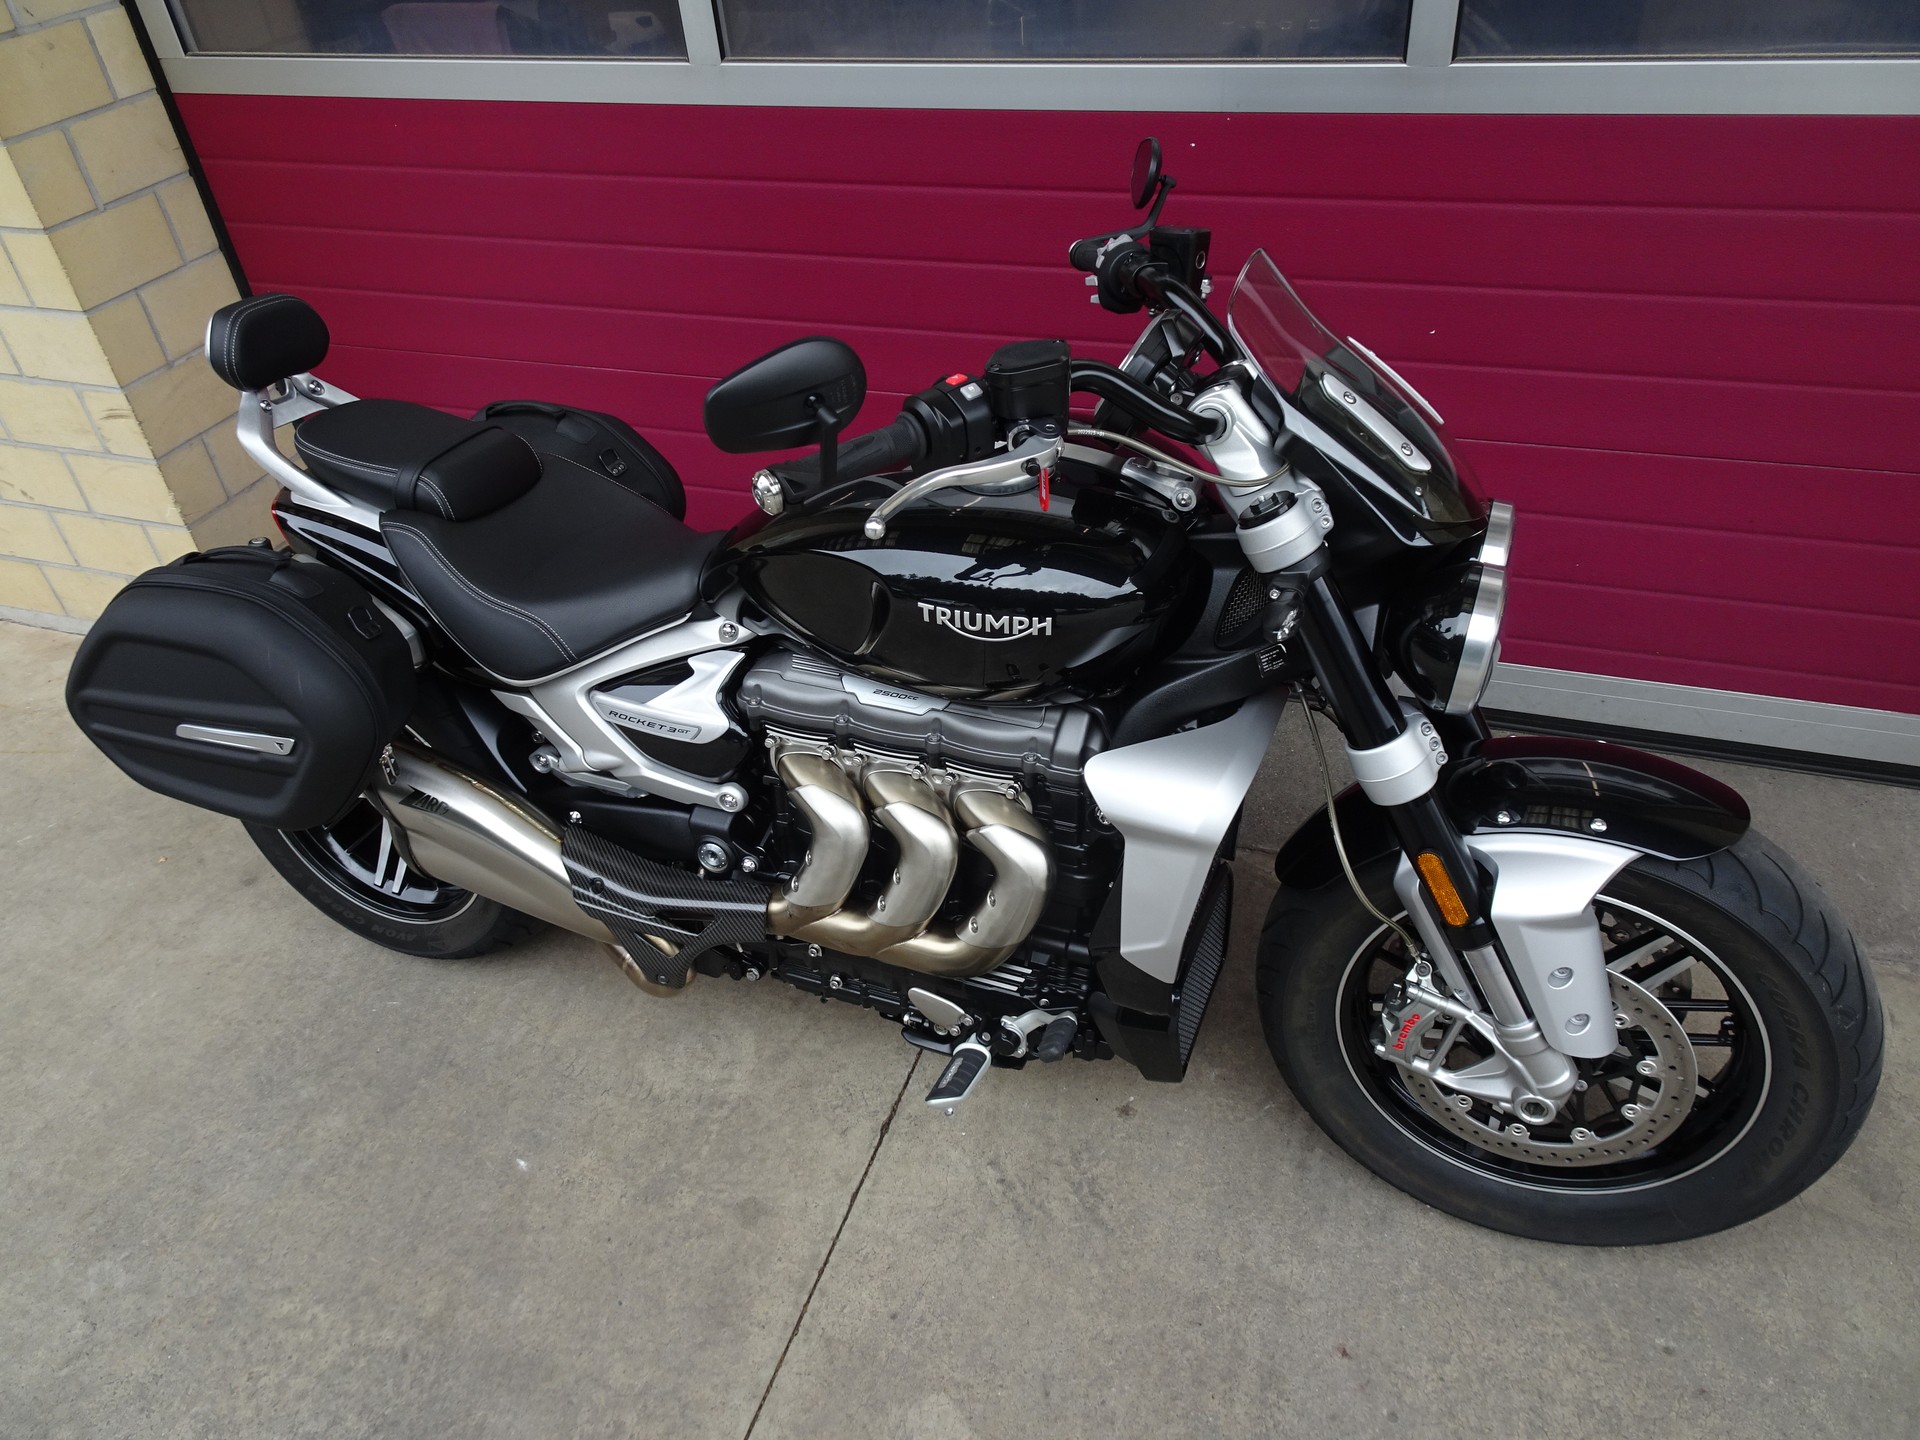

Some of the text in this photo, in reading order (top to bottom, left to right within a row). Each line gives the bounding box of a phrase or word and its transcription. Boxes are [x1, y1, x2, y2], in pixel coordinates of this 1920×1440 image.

[917, 601, 1053, 642] TRIUMPH
[872, 688, 919, 701] 2500cc
[608, 710, 667, 730] ROCKET
[1392, 1013, 1421, 1051] brembo
